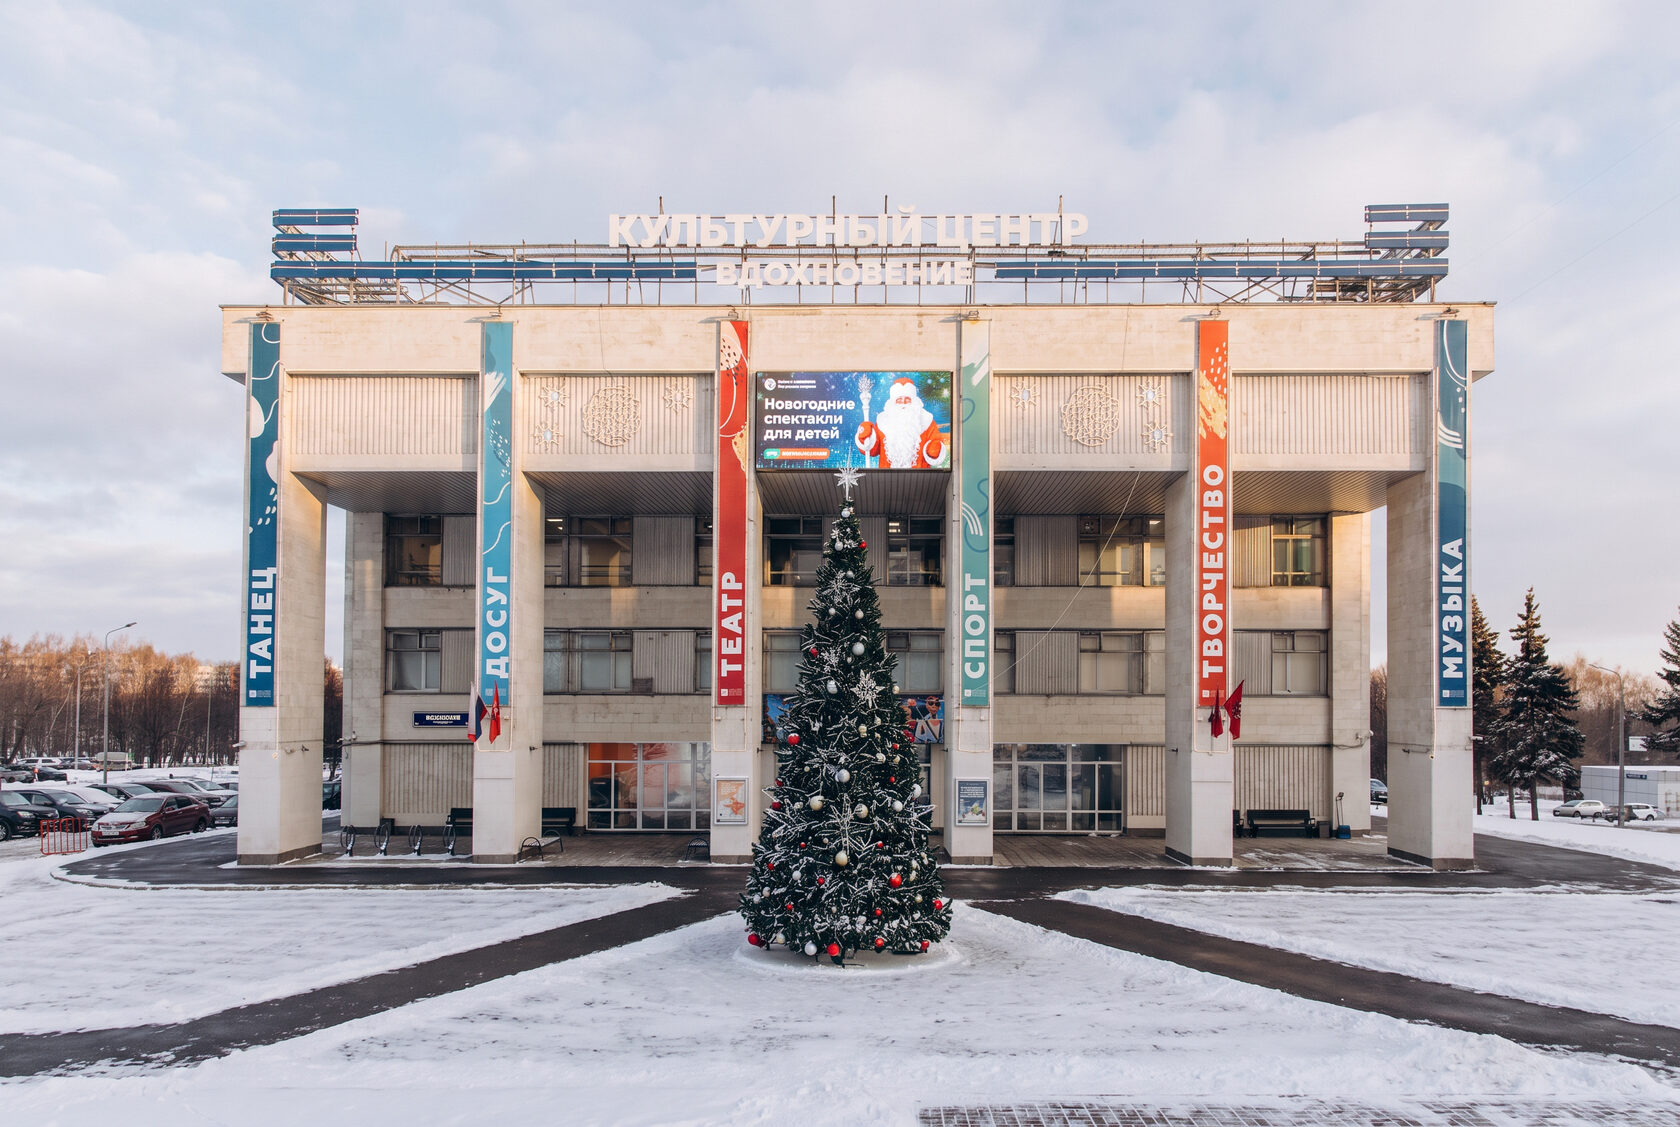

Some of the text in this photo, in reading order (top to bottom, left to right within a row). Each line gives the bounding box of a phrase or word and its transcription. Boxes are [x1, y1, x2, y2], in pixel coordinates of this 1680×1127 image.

[608, 205, 1089, 252] КУЛЬТУРНЫЙ ЦЕНТР
[715, 261, 973, 290] ВДОХНОВЕНИЕ
[763, 415, 843, 425] спектакли
[764, 398, 855, 412] Новогодние
[764, 427, 840, 441] для детей
[249, 566, 277, 679] ТАНЕЦ
[485, 566, 509, 679] ДОСУГ
[720, 571, 743, 678] ТЕАТР
[1202, 464, 1224, 679] ТВОРЧЕСТВО
[1441, 537, 1464, 679] МУЗЫКА
[964, 572, 986, 680] СПОРТ
